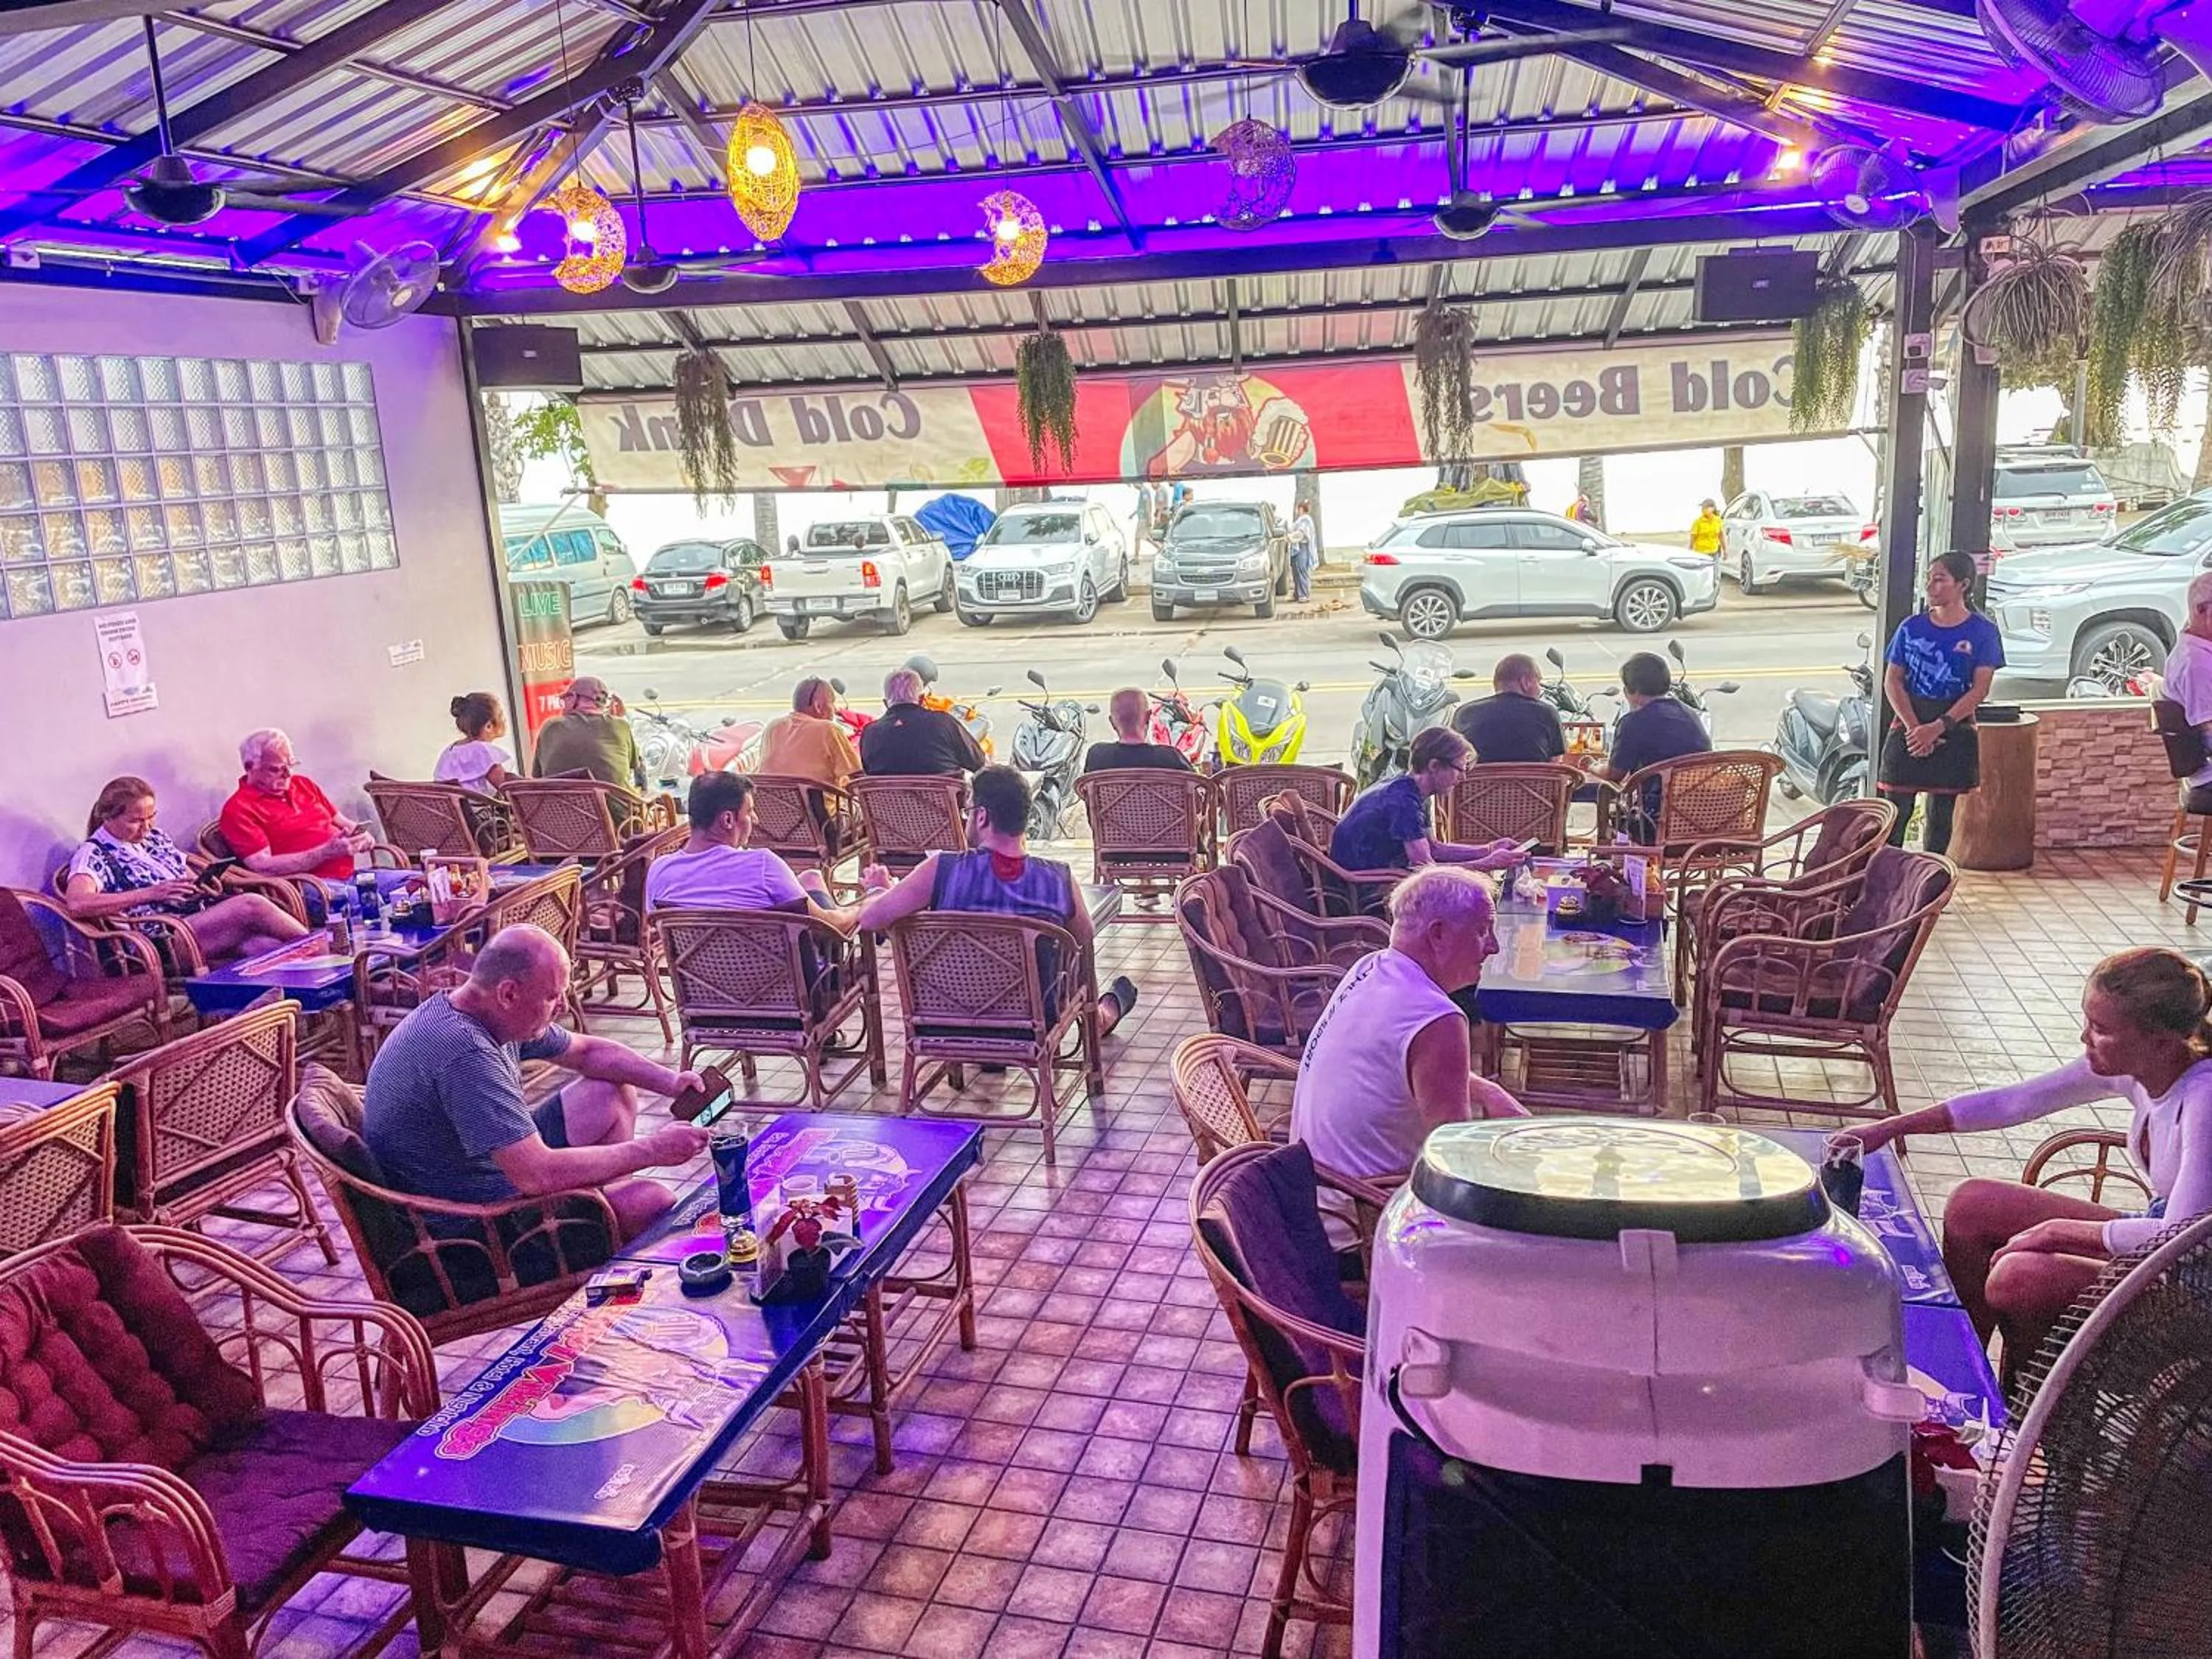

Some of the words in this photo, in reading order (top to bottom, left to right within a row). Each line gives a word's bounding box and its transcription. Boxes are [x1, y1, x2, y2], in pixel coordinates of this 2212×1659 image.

[519, 591, 563, 618] LIVE
[518, 639, 572, 673] MUSIC
[538, 695, 546, 713] 7
